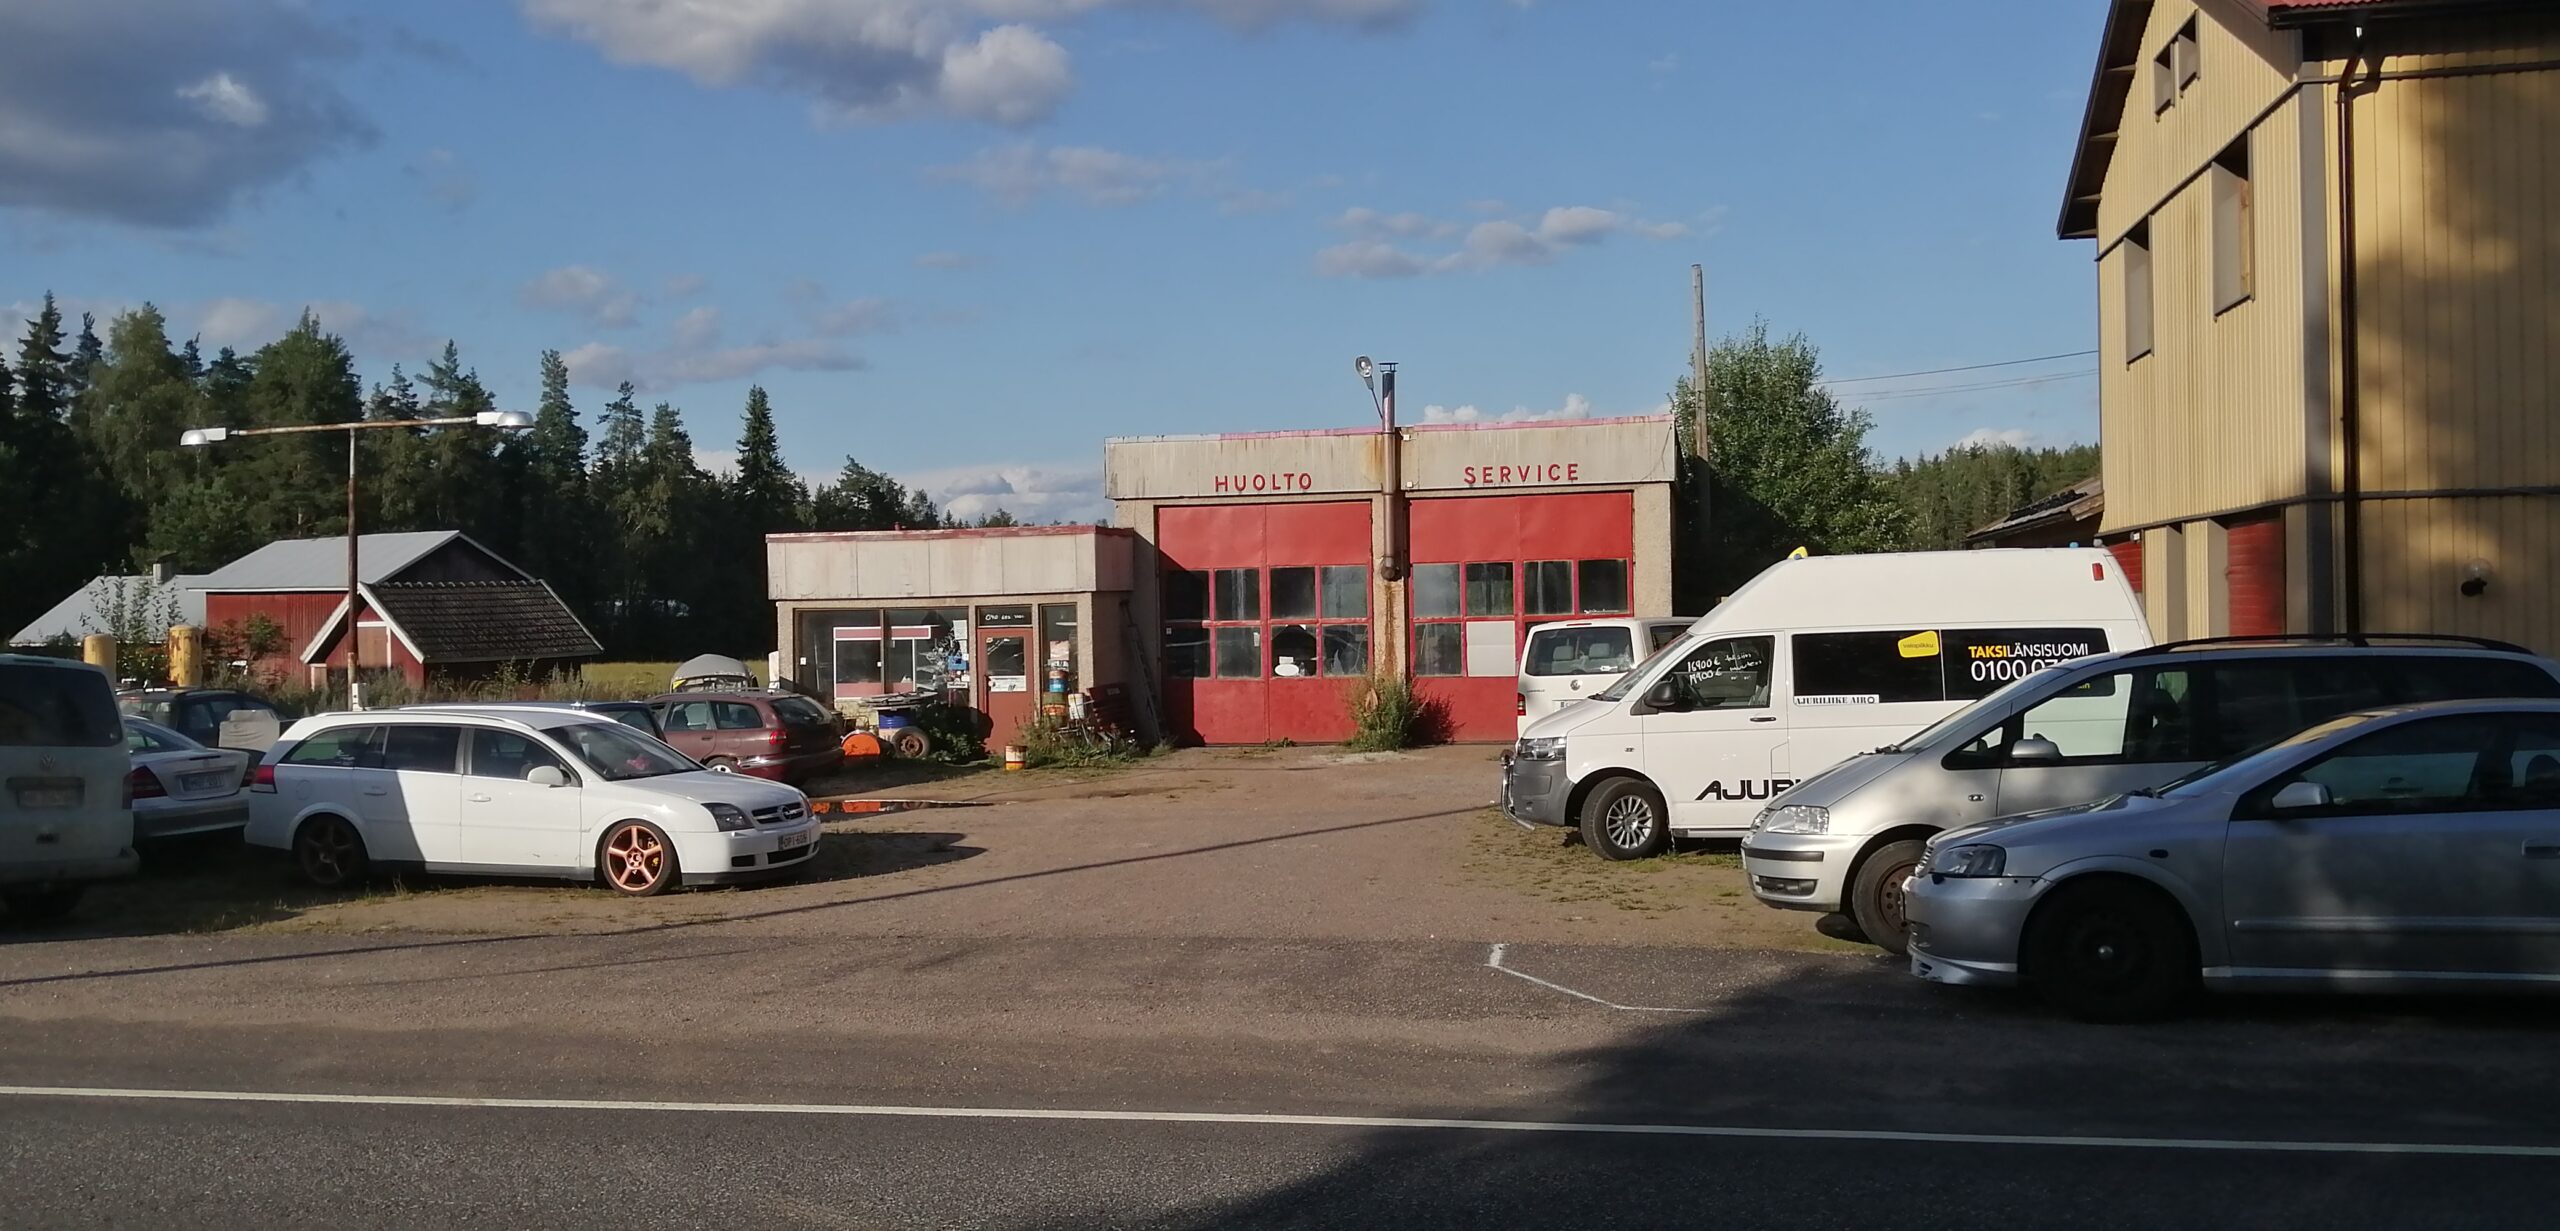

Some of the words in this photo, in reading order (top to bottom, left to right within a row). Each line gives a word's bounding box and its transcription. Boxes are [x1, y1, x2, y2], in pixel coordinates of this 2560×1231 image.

[1215, 473, 1312, 492] HUOLTO
[1464, 463, 1579, 484] SERVICE
[1968, 642, 2089, 658] TAKSILÄNSISUOMI
[1970, 660, 2027, 681] 0100
[1796, 696, 1848, 705] AJURILIIKE
[1851, 696, 1876, 705] AIRO
[1694, 779, 1801, 801] AJUR
